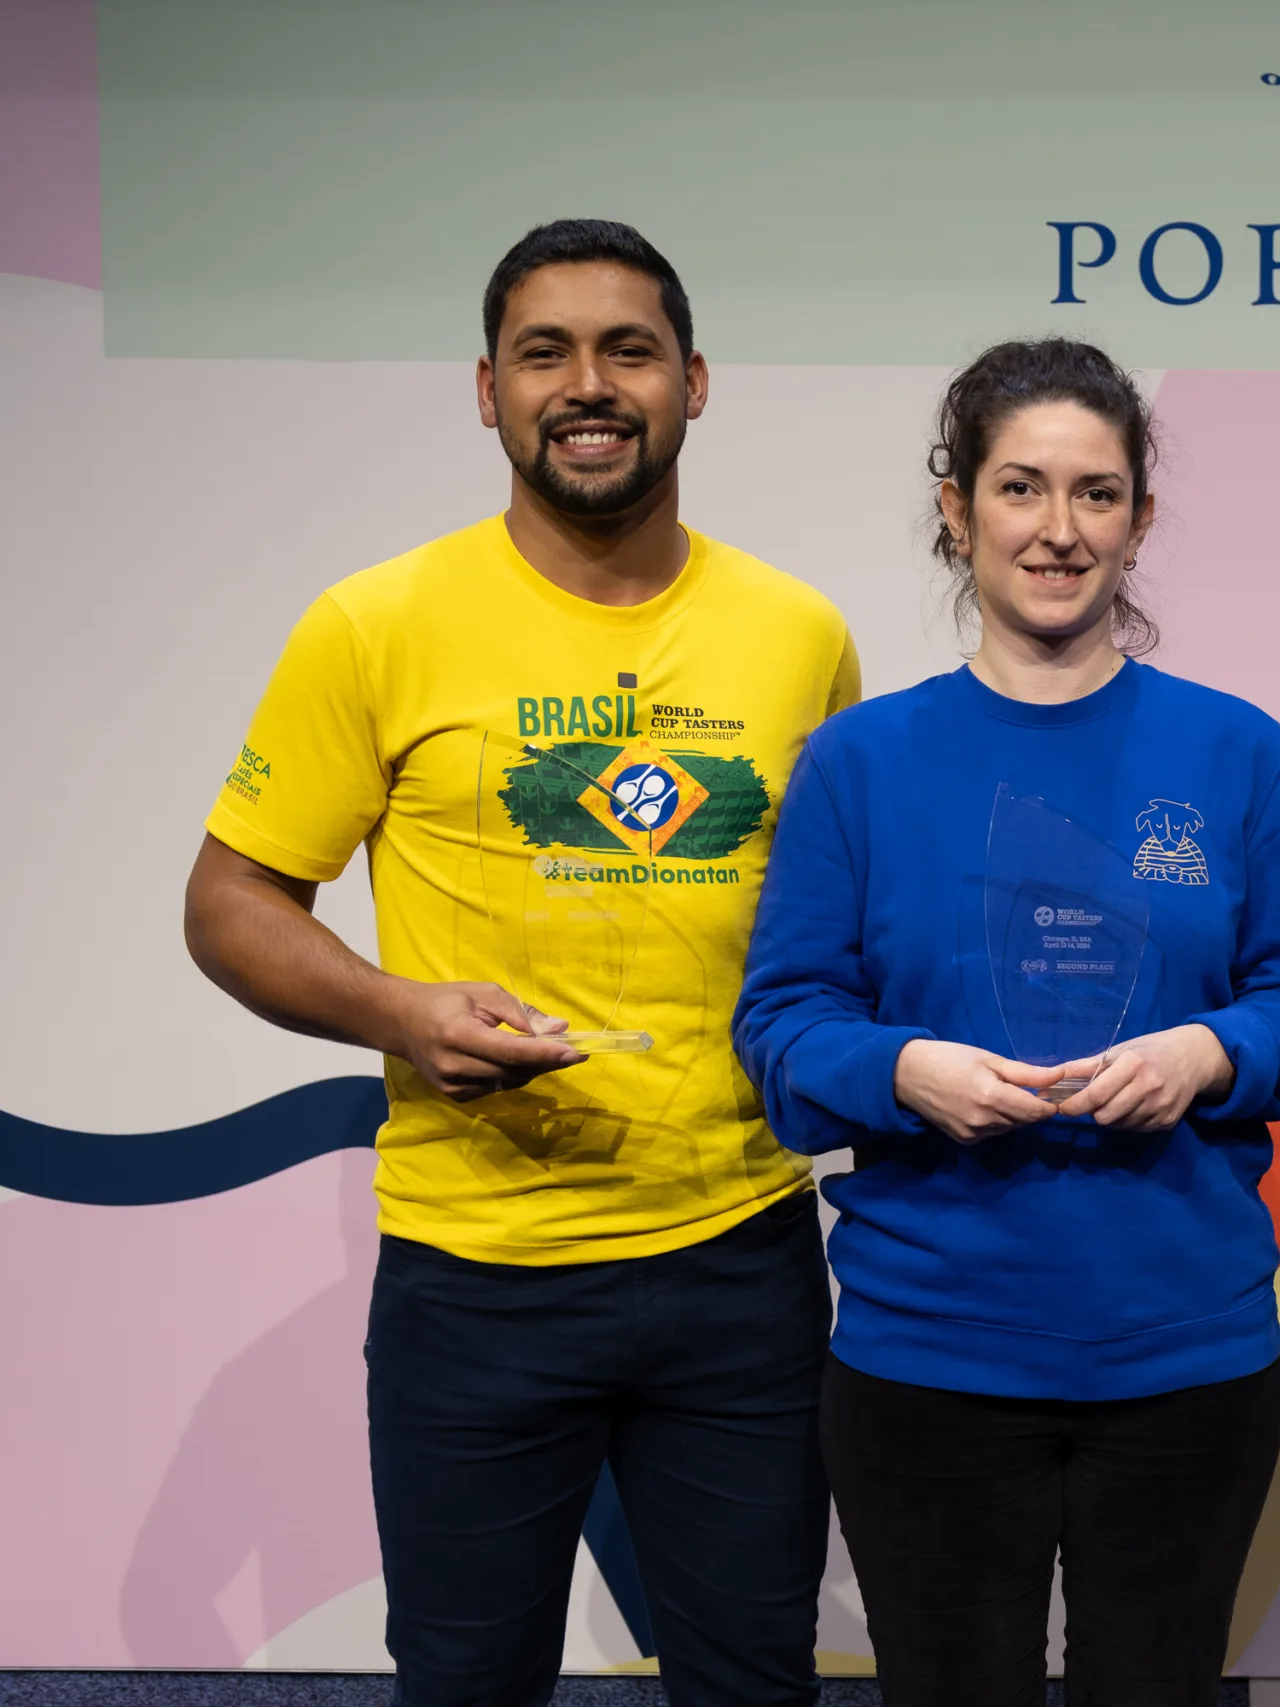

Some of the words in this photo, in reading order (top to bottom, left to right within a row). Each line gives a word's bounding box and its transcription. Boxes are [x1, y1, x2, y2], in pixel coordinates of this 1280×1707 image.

[517, 694, 643, 738] BRASIL
[652, 704, 704, 717] WORLD
[651, 718, 679, 729] CUP
[683, 719, 745, 730] TASTERS
[232, 772, 261, 796] ESPECIAIS
[236, 786, 259, 805] BRASIL
[545, 861, 739, 884] #TeamDionatan
